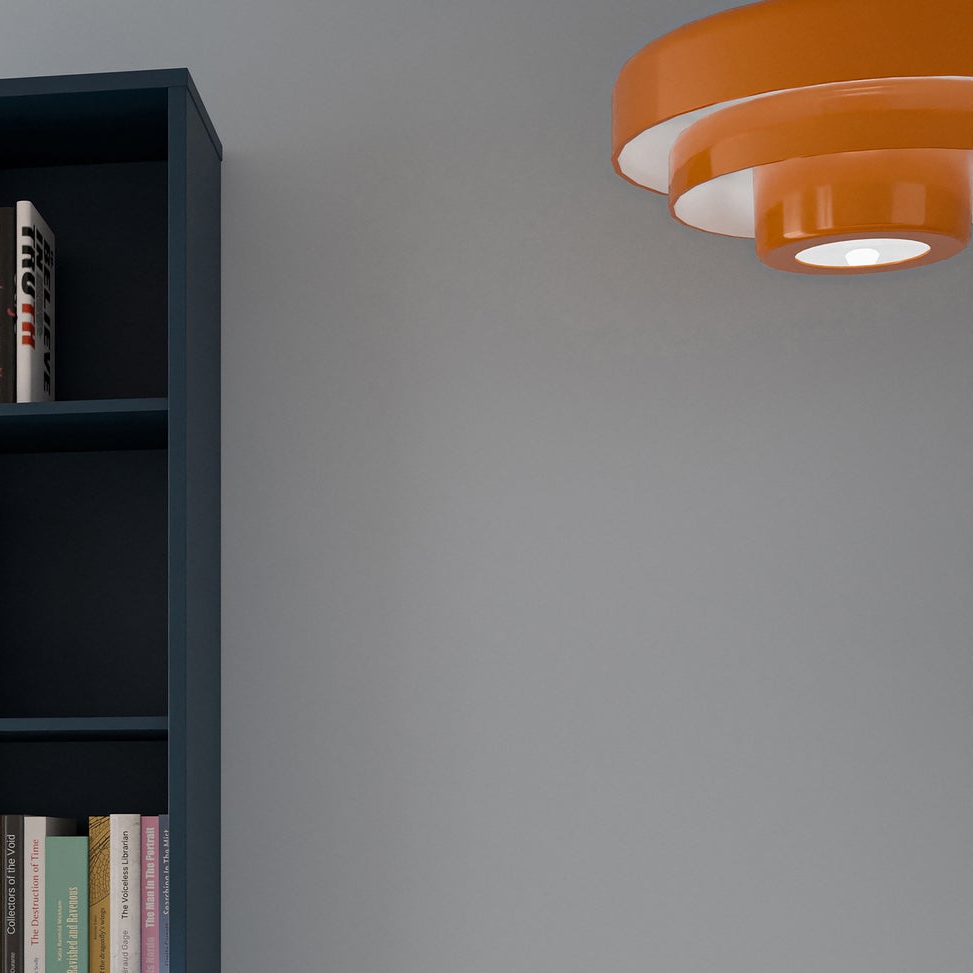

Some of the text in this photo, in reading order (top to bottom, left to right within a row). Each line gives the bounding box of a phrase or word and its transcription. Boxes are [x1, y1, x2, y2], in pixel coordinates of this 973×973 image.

[36, 229, 43, 269] IN
[21, 225, 36, 350] TRUTH
[43, 239, 51, 396] BELIEVE
[145, 828, 155, 860] Portrait
[7, 835, 15, 934] Collectors of the Void
[145, 863, 155, 877] The
[31, 840, 39, 945] The Destruction of Time
[66, 887, 78, 923] Ravenous
[145, 892, 155, 909] Man
[66, 925, 78, 938] and
[145, 912, 155, 926] The
[121, 931, 130, 950] Gage
